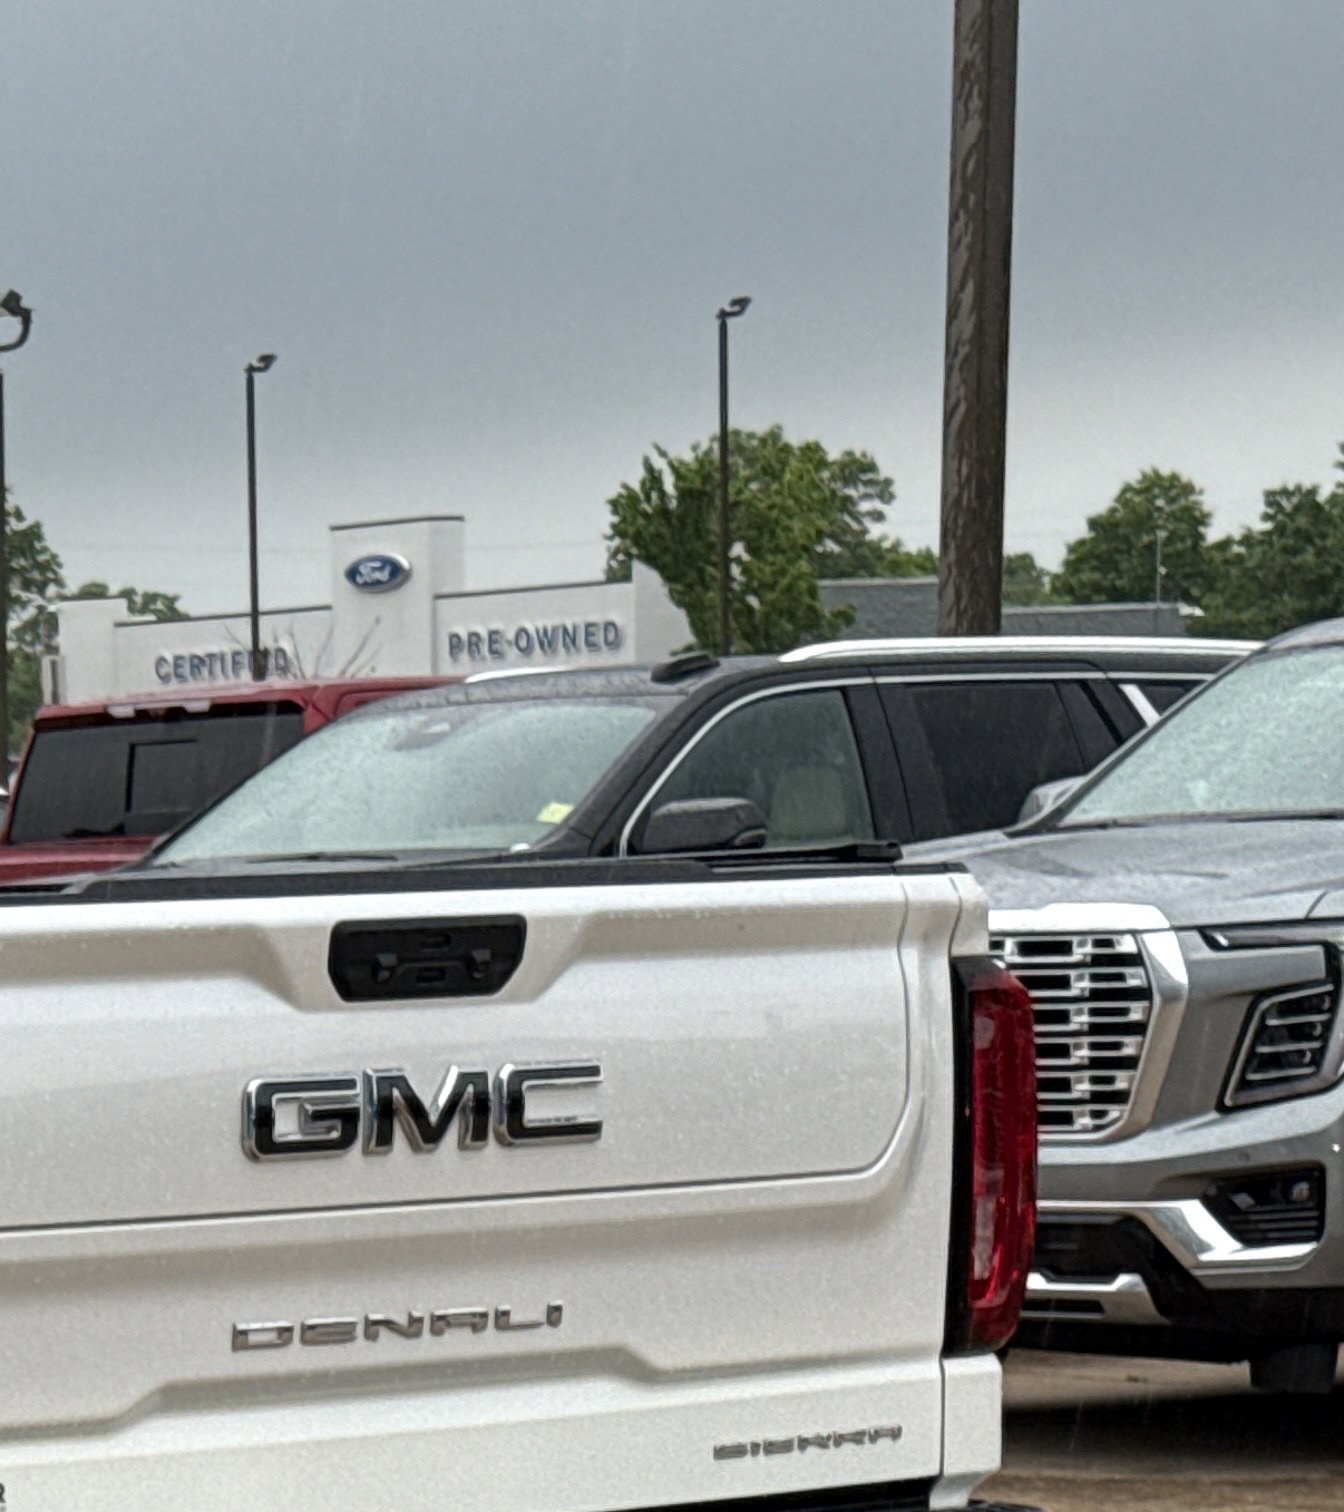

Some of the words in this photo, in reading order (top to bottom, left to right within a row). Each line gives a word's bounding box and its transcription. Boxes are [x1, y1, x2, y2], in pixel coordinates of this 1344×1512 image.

[355, 561, 391, 585] Ford
[448, 621, 624, 662] PRE-OWNED
[154, 647, 290, 684] CERTIFID
[242, 1058, 604, 1163] GMC
[232, 1300, 564, 1352] DENALI
[713, 1424, 903, 1461] SIERRA
